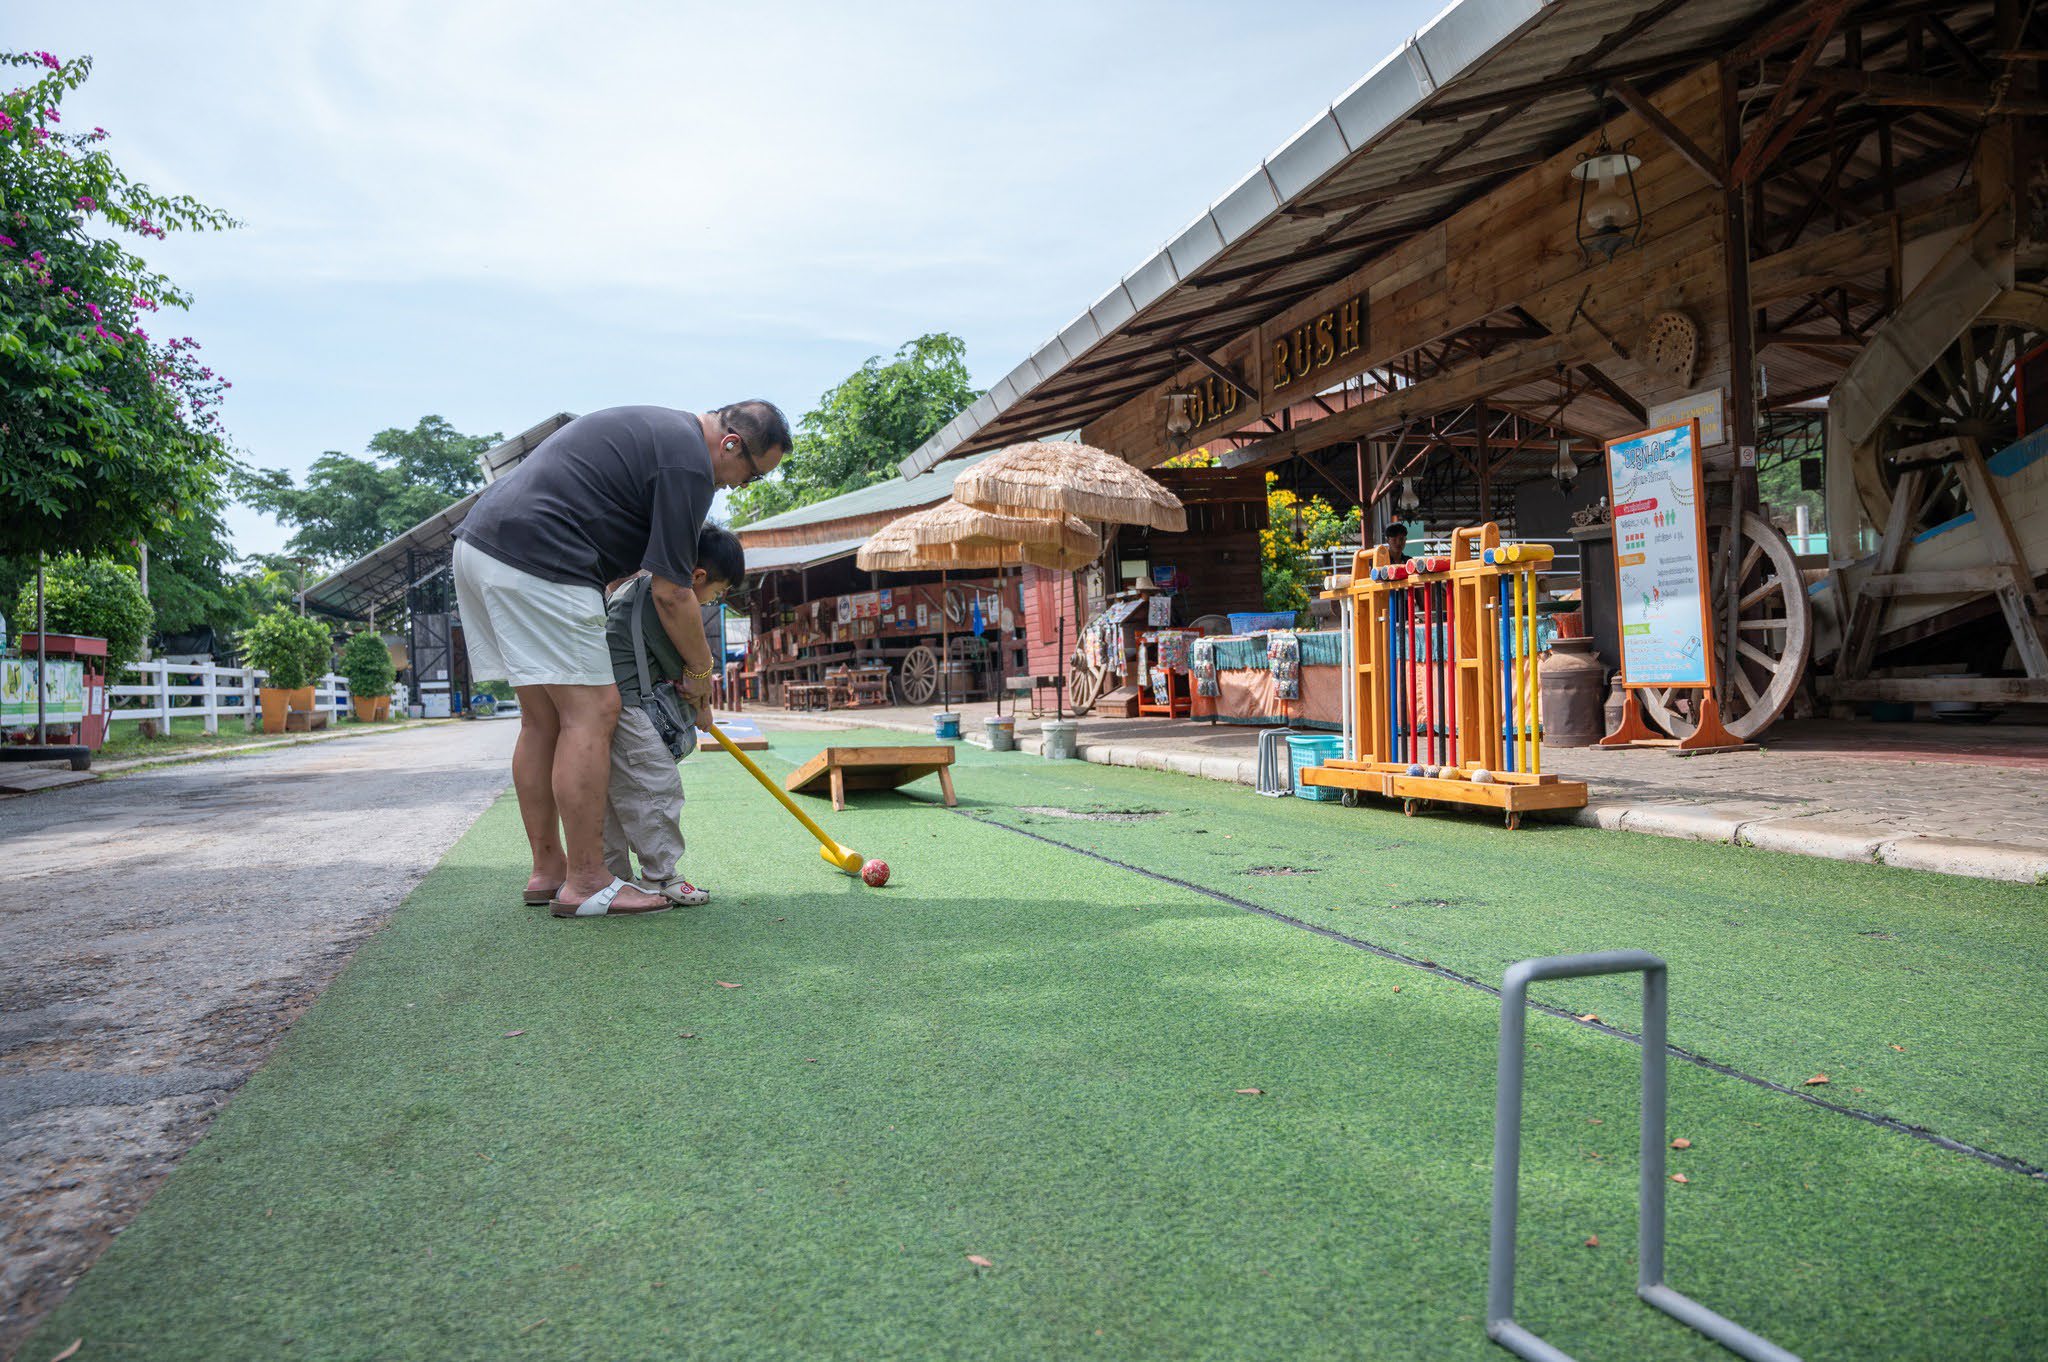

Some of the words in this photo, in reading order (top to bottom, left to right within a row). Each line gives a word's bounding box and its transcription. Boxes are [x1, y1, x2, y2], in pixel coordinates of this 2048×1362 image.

[1178, 376, 1238, 431] OLD
[1272, 297, 1361, 391] RUSH
[1624, 440, 1675, 470] CORNHOLE
